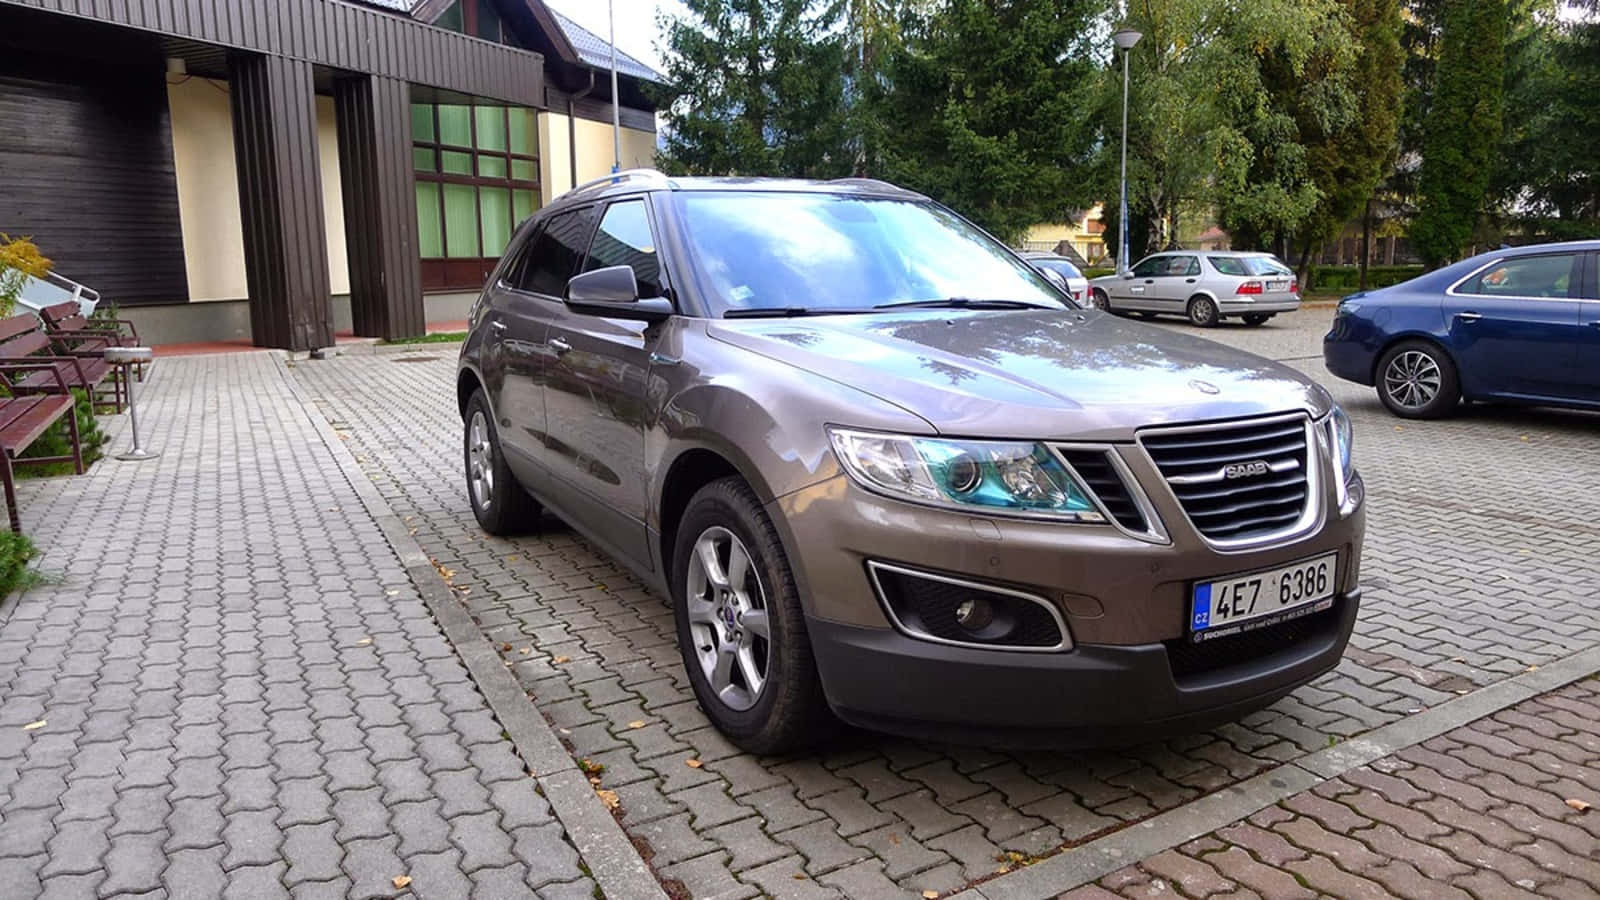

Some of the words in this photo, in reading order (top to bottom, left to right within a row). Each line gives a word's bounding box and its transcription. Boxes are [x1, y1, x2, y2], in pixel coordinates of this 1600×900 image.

[1225, 462, 1267, 479] SAAB
[1216, 579, 1262, 619] 4E7
[1280, 562, 1327, 604] 6386
[1195, 612, 1209, 625] CZ
